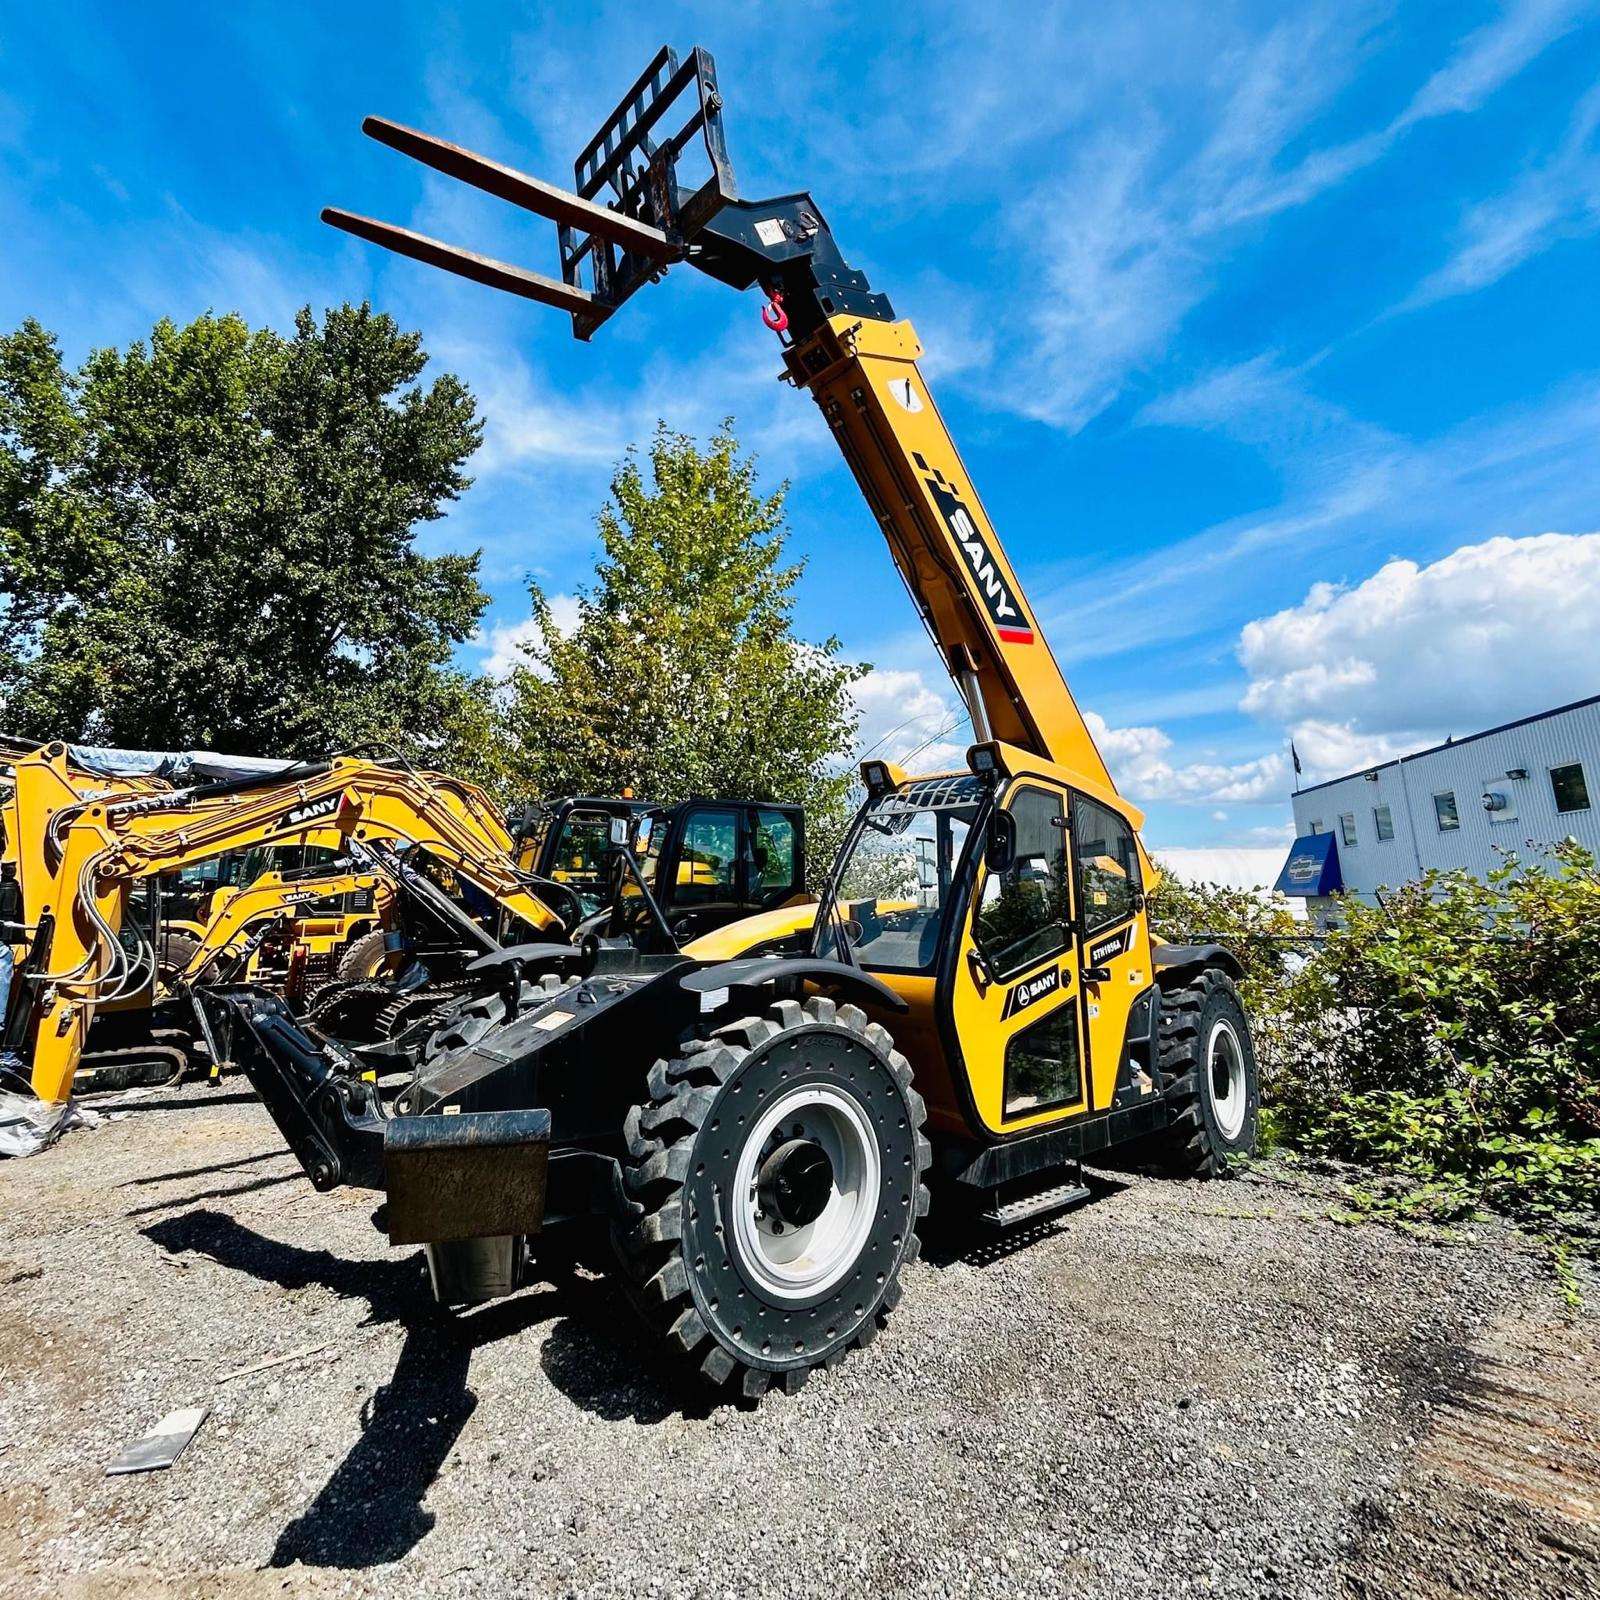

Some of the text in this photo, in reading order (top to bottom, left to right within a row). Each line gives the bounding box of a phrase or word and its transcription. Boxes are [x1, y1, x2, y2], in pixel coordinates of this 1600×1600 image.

[949, 508, 1016, 618] SANY
[289, 798, 336, 823] SANY
[286, 892, 311, 902] SANY
[1029, 972, 1056, 997] SANY
